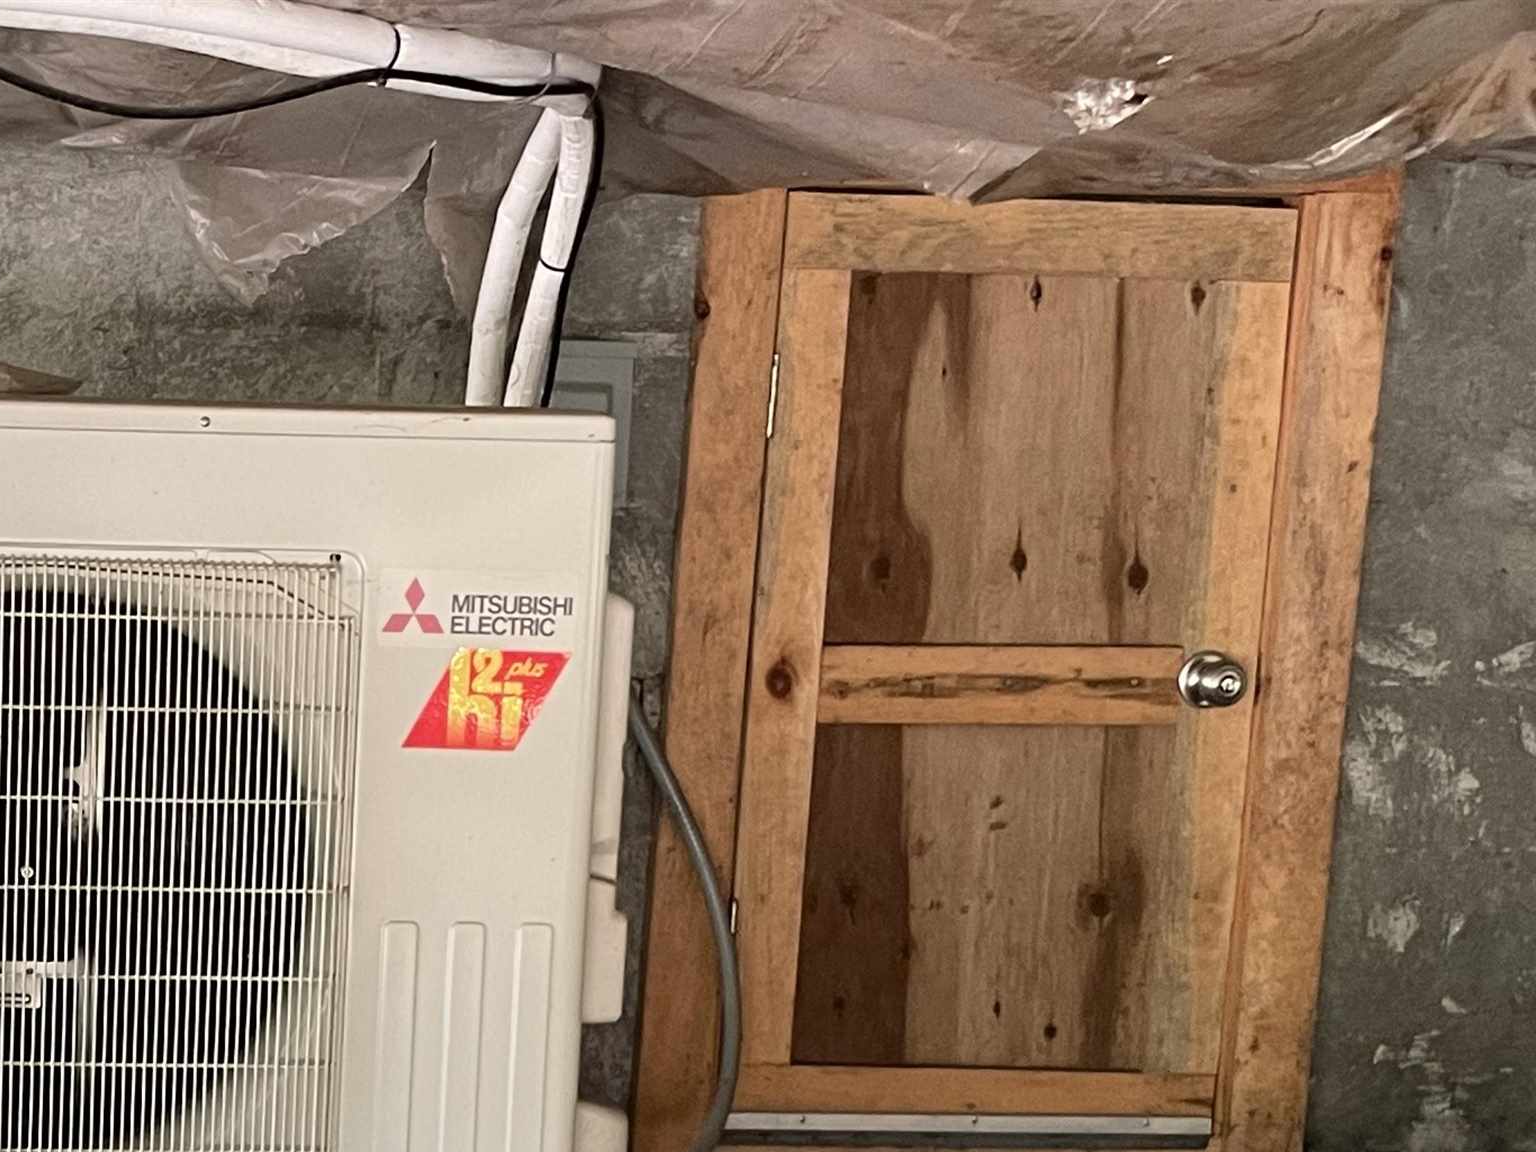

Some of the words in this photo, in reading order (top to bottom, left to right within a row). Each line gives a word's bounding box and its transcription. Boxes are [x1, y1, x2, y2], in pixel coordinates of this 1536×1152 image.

[450, 594, 573, 616] MITSUBISHI
[450, 617, 556, 637] ELECTRIC
[505, 657, 549, 680] plus
